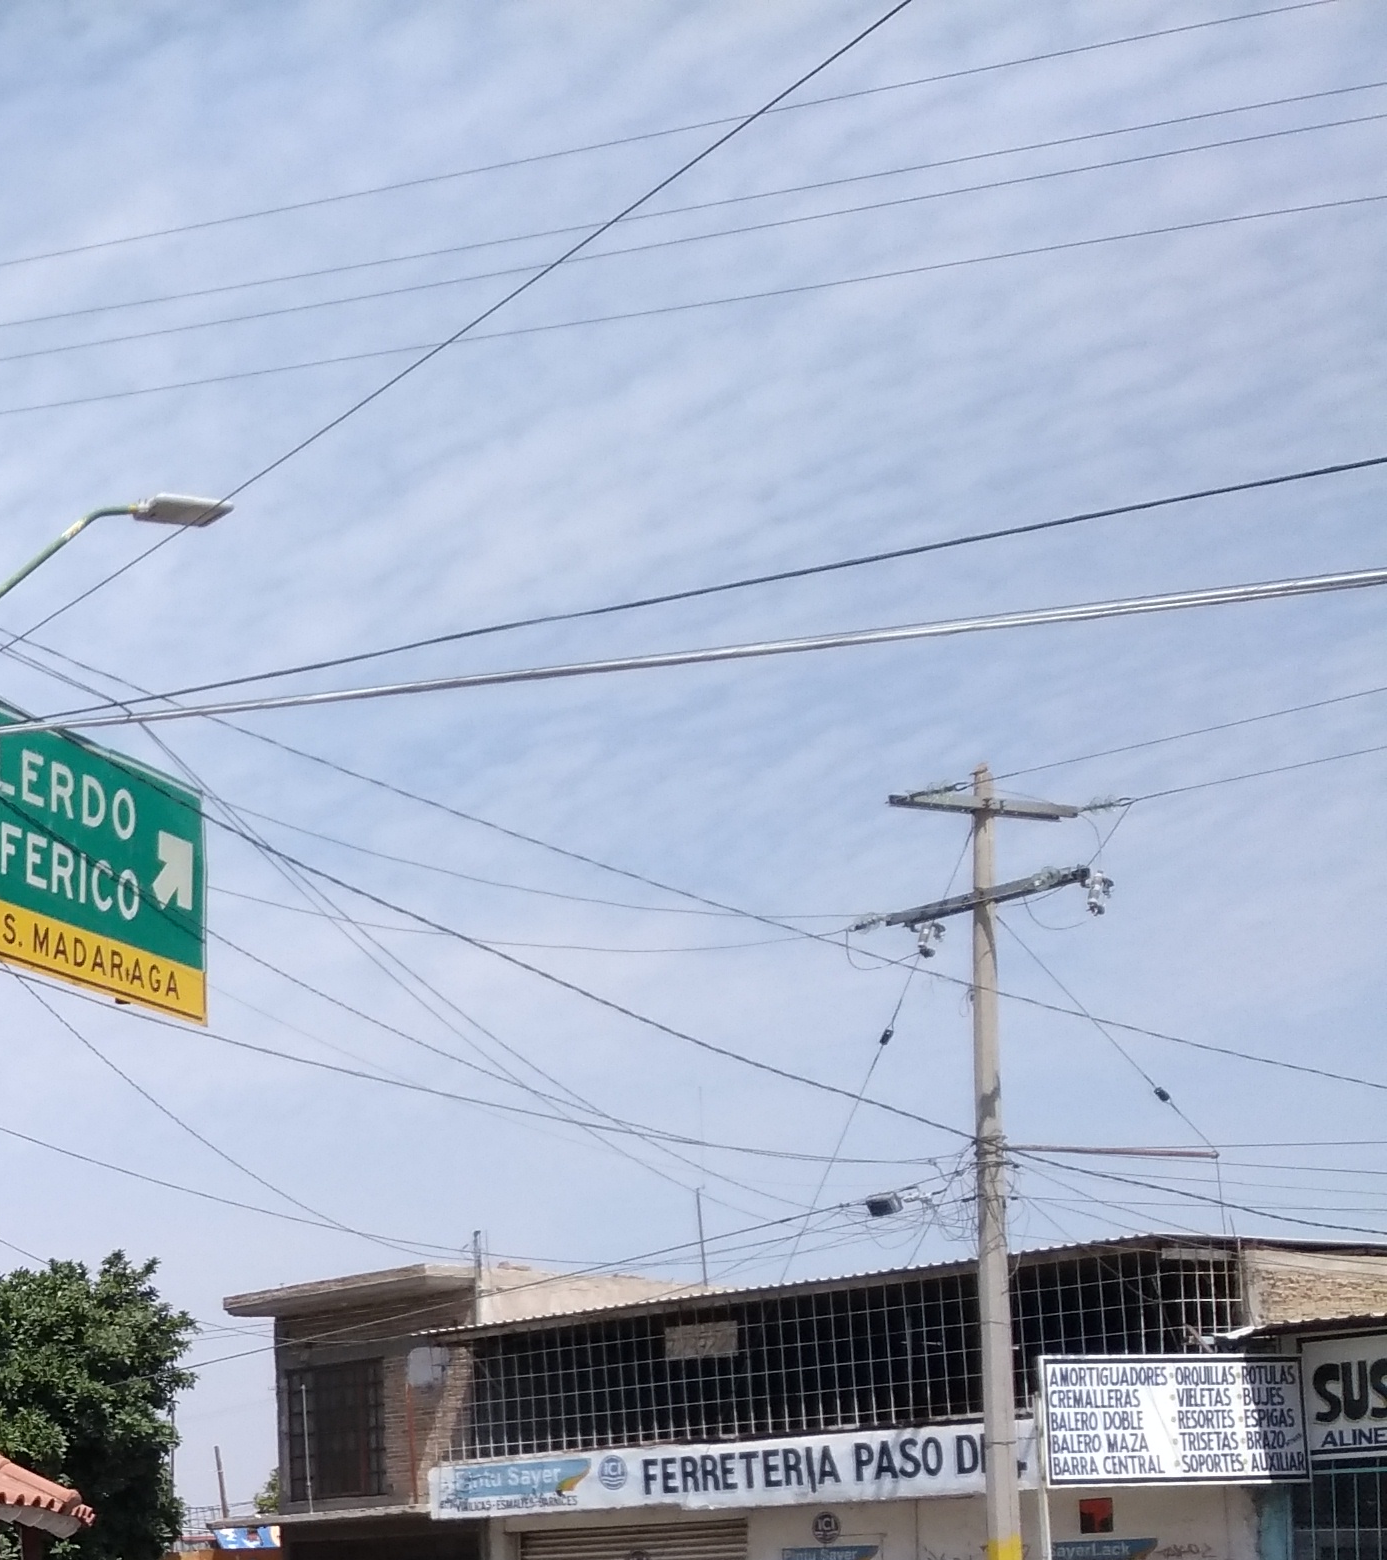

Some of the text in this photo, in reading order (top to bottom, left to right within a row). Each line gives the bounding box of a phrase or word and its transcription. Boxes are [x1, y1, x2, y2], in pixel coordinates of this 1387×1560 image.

[3, 914, 24, 947] S.
[1049, 1365, 1296, 1387] AMORTIGUADORES ORQUILLAS ROTULAS
[1050, 1389, 1141, 1408] CREMALLERAS
[1243, 1387, 1285, 1406] BUJES
[1050, 1408, 1294, 1431] BALERO DOBLE RESORTES ESPIGAS
[1052, 1434, 1102, 1454] BALERO
[1107, 1433, 1149, 1452] MAZA
[1180, 1432, 1239, 1451] TRISETAS
[1246, 1431, 1286, 1450] BRAZO
[1321, 1427, 1387, 1448] ALINE
[642, 1444, 841, 1495] FERRETERIA
[854, 1437, 943, 1482] PASO
[1053, 1452, 1306, 1475] BARRA CENTRAL SOPORTES AUXILIAR
[508, 1467, 562, 1488] Sayer
